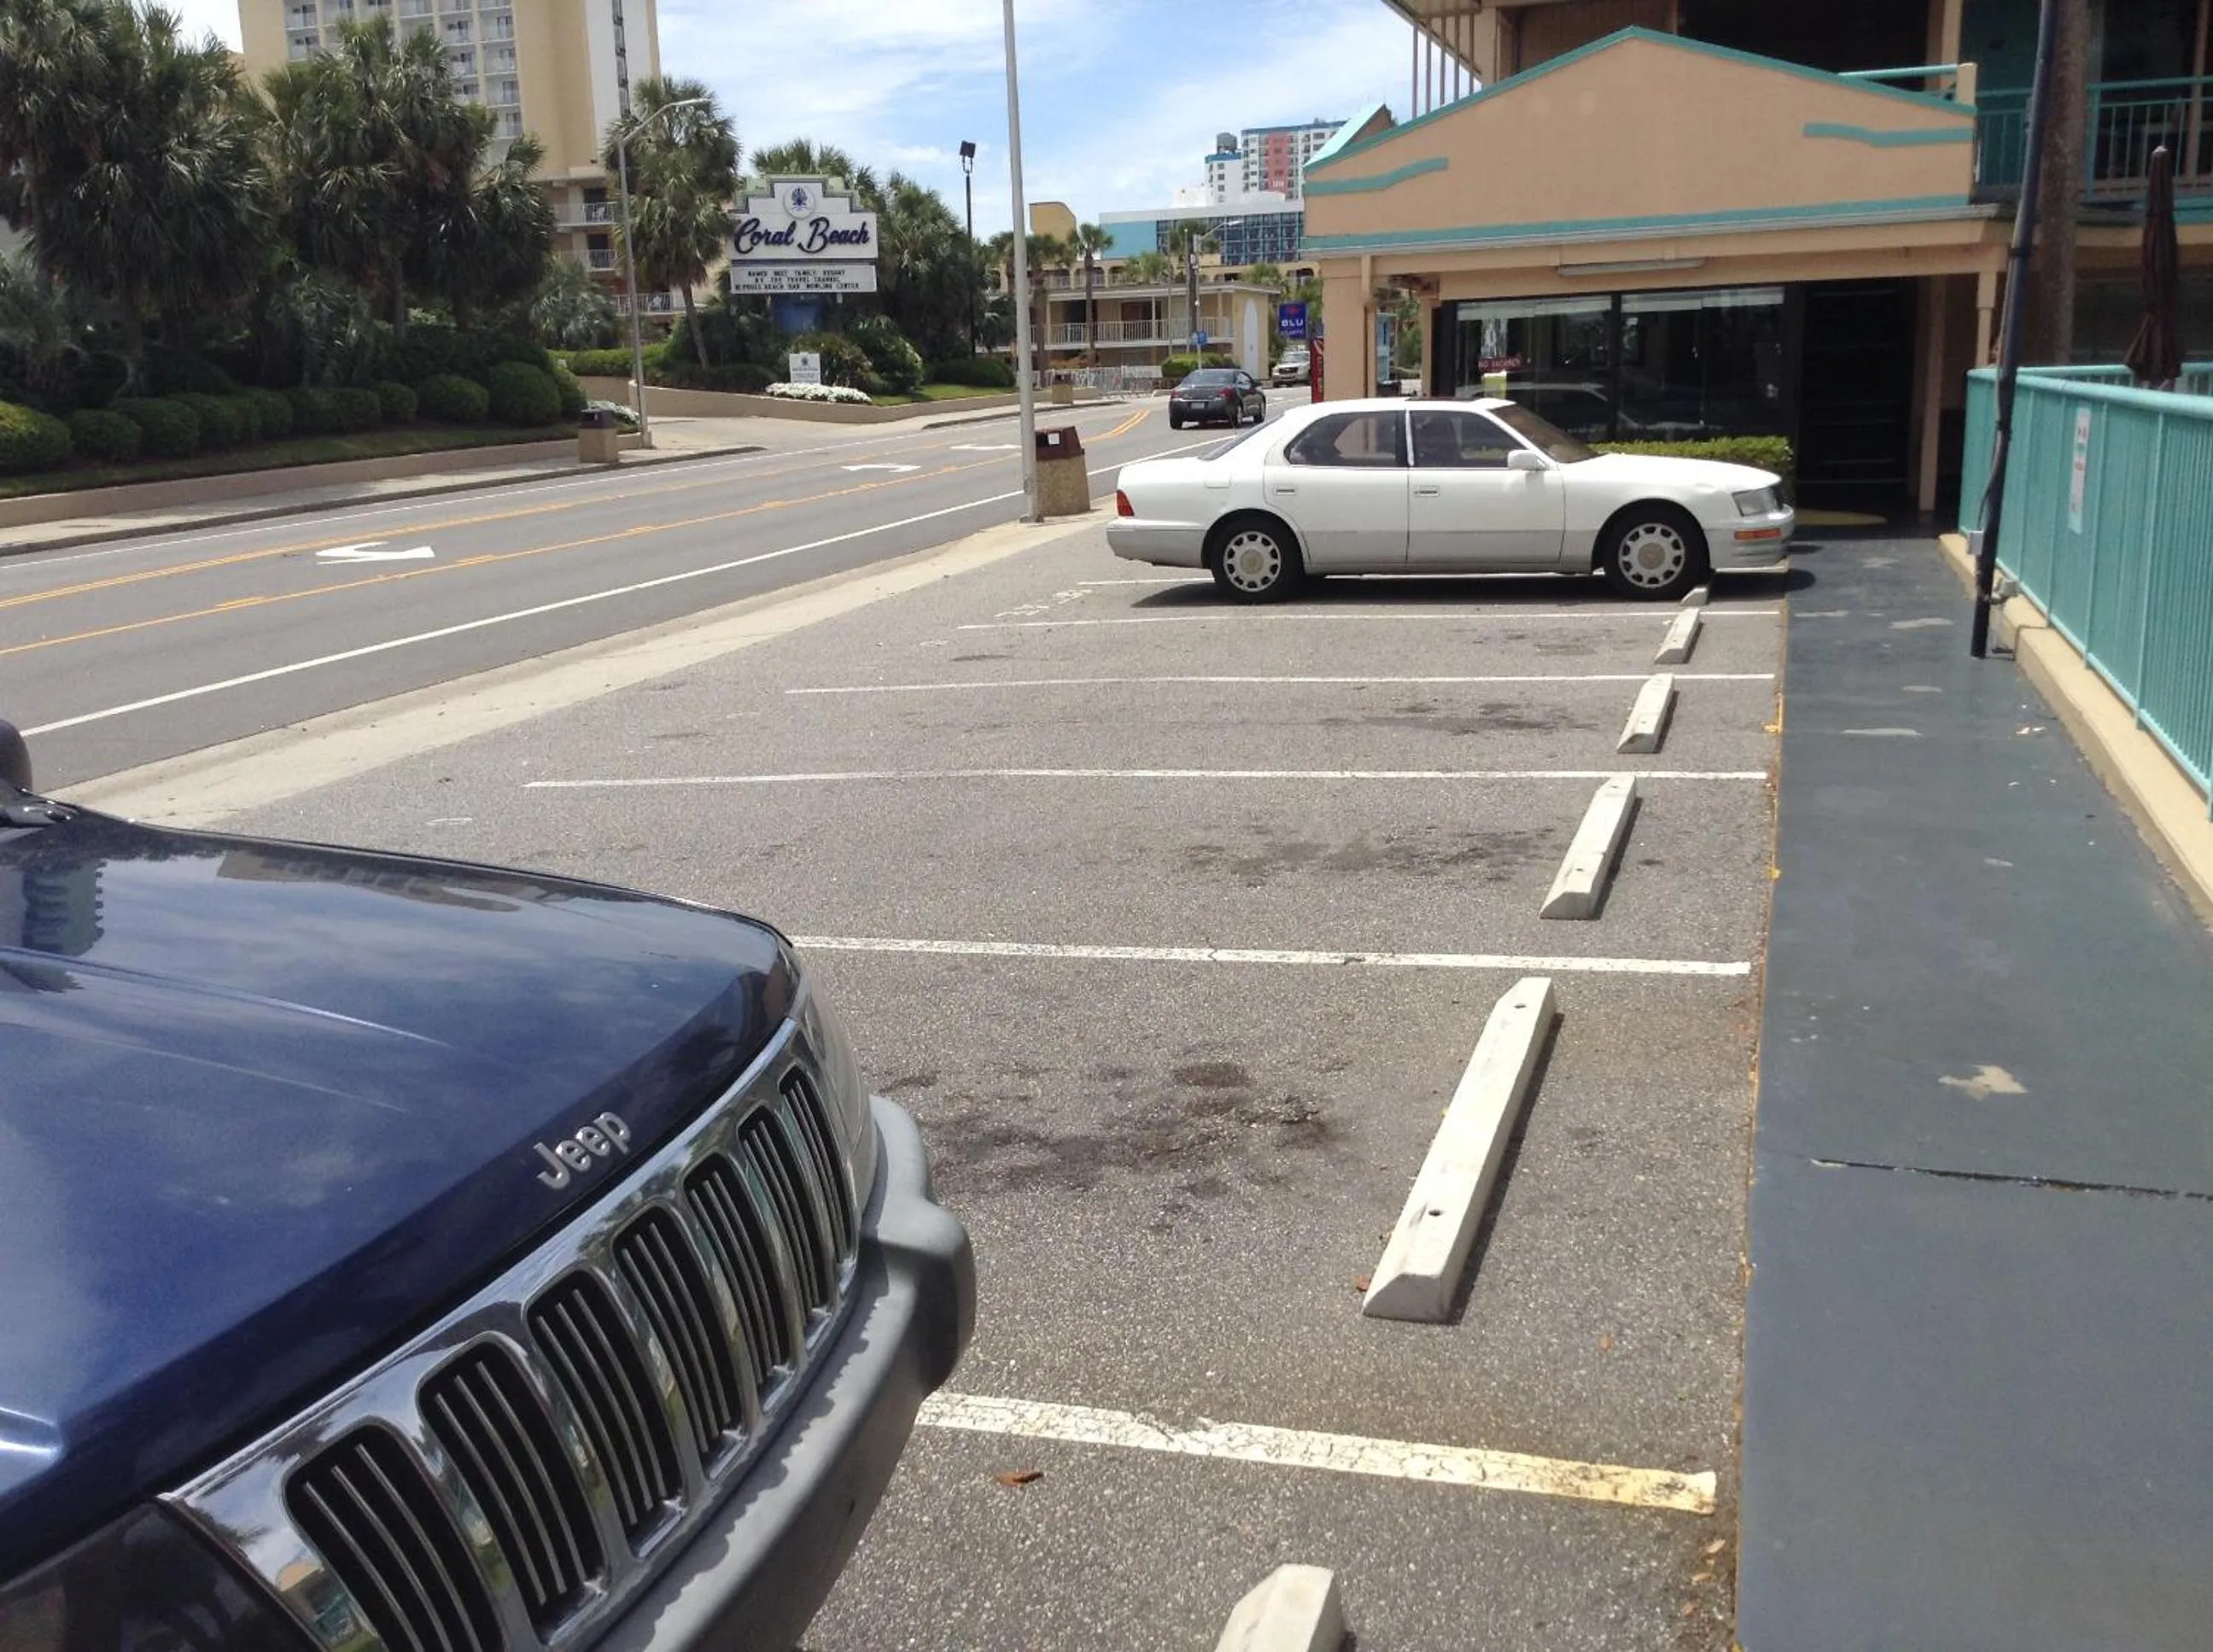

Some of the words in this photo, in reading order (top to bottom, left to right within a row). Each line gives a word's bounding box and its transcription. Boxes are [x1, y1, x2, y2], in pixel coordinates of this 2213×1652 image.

[734, 218, 797, 254] Coral
[797, 216, 870, 254] Beach
[1281, 318, 1304, 327] BLU
[533, 1112, 632, 1189] Jeep
